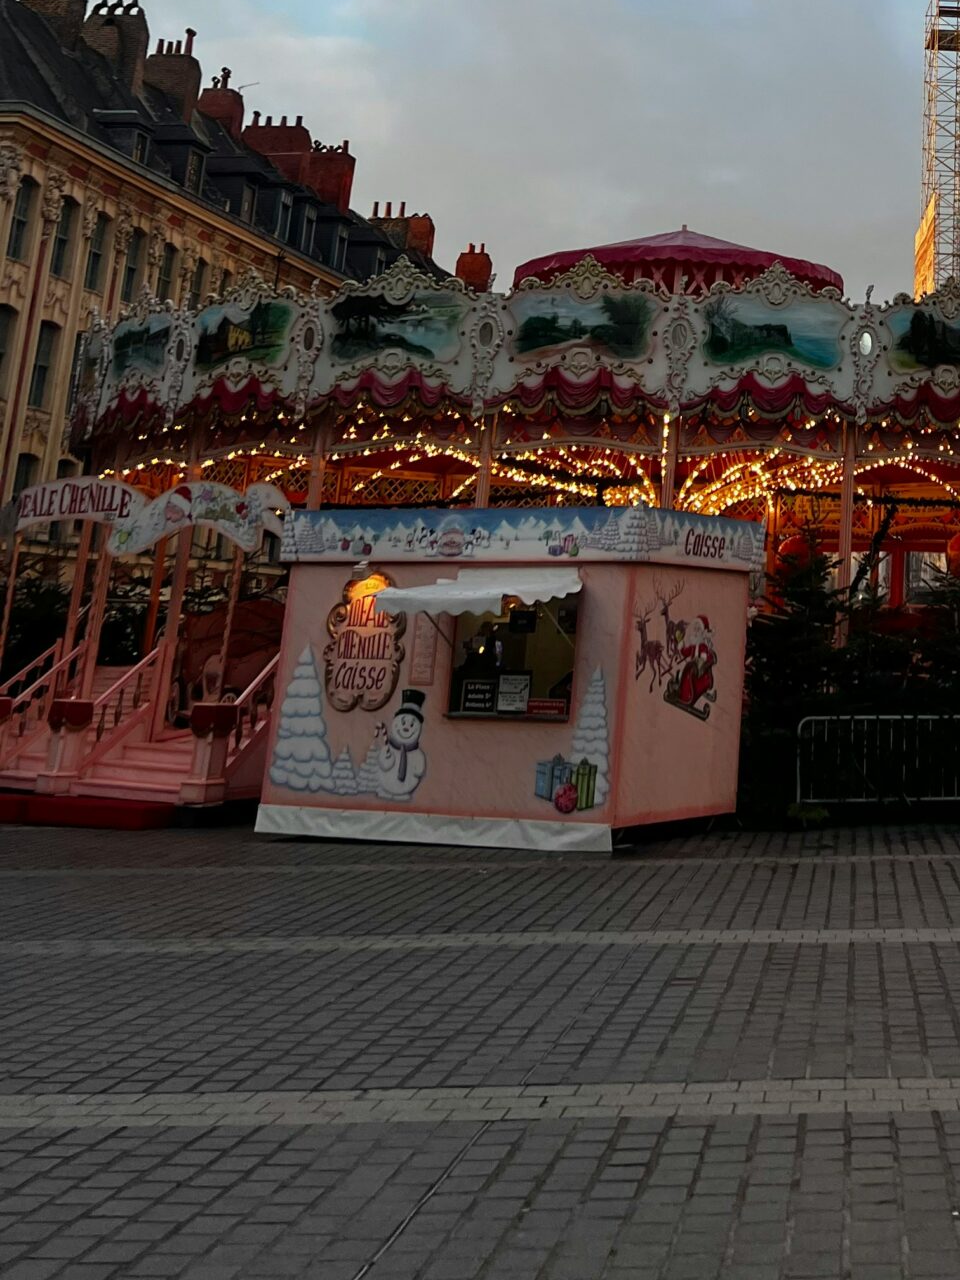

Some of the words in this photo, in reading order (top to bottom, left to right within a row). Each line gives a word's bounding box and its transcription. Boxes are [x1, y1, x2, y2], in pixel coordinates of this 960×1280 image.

[59, 483, 132, 519] CHENILLE
[684, 528, 726, 559] Caisse
[338, 630, 392, 660] CHENILLE
[335, 662, 387, 689] Caisse
